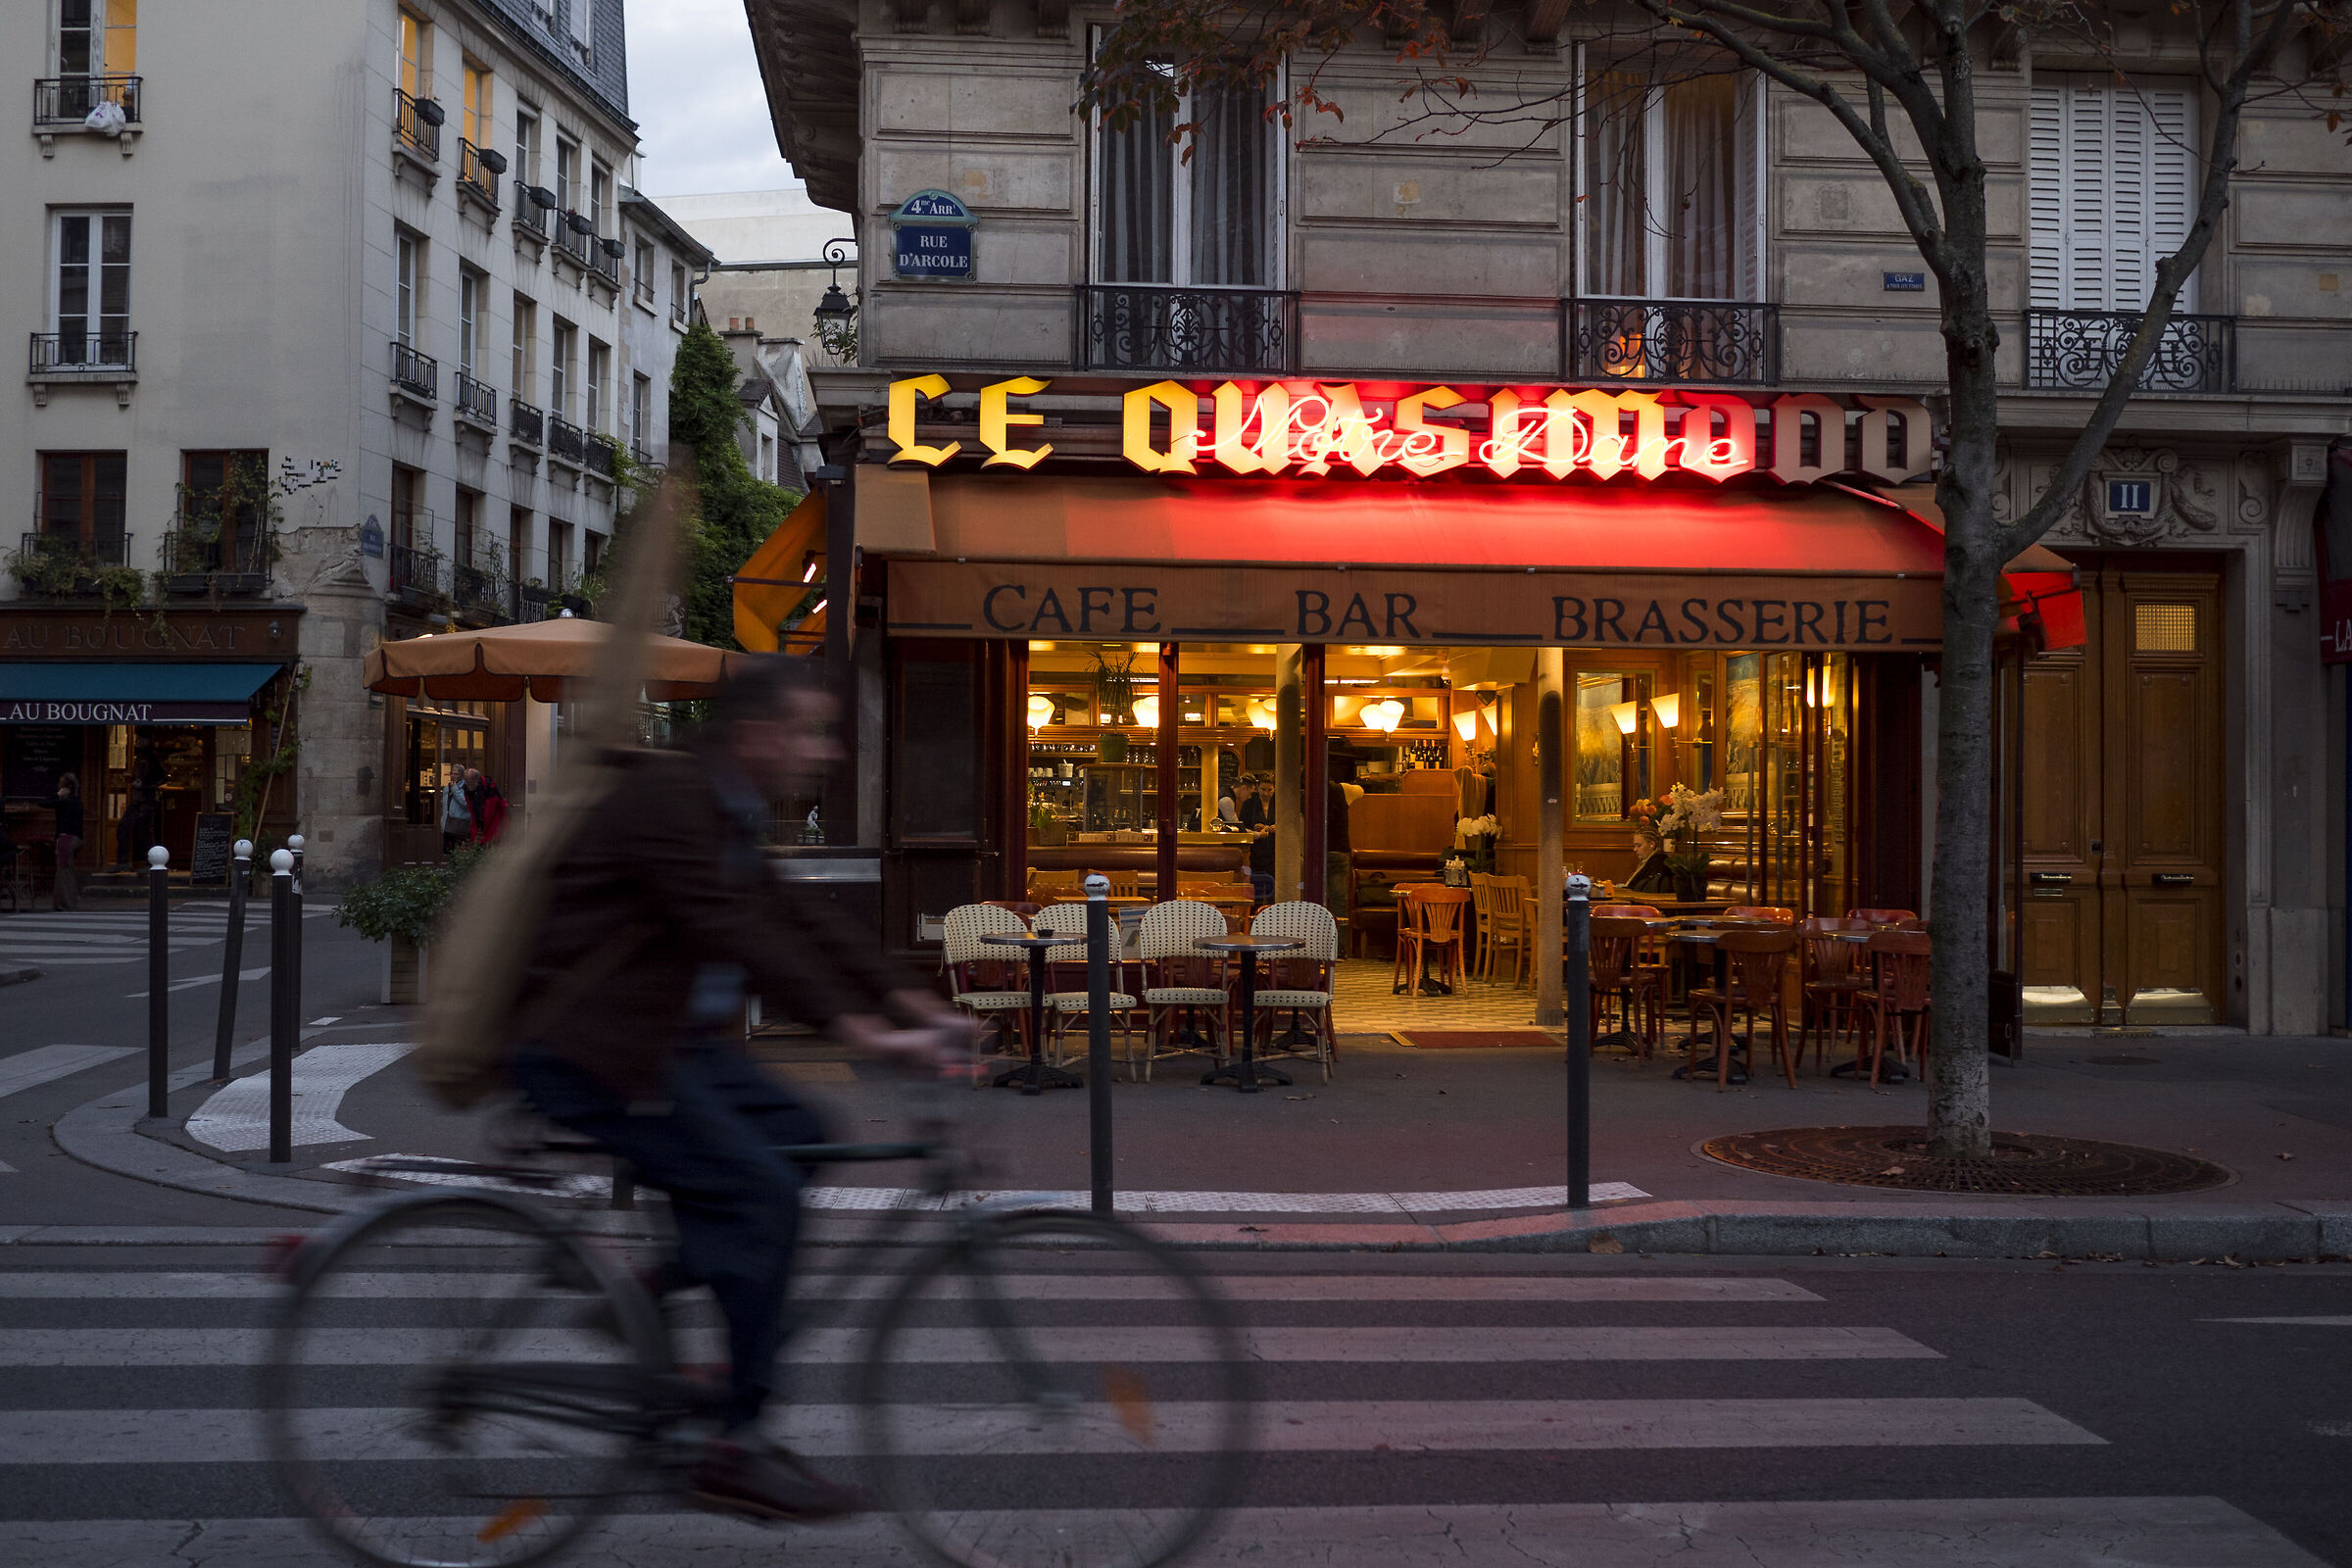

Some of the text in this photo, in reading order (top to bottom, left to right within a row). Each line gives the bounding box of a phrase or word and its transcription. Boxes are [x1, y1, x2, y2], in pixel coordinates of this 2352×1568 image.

[920, 236, 948, 247] RUE
[899, 252, 968, 268] D'ARCOLE
[1894, 273, 1914, 282] GAZ
[1188, 395, 1749, 470] Notre Dame
[2120, 484, 2139, 509] 11
[983, 584, 1893, 645] CAFE BAR BRASSERIE
[1, 625, 245, 650] AU BOUGNAT
[9, 703, 153, 721] AU BOUGNAT
